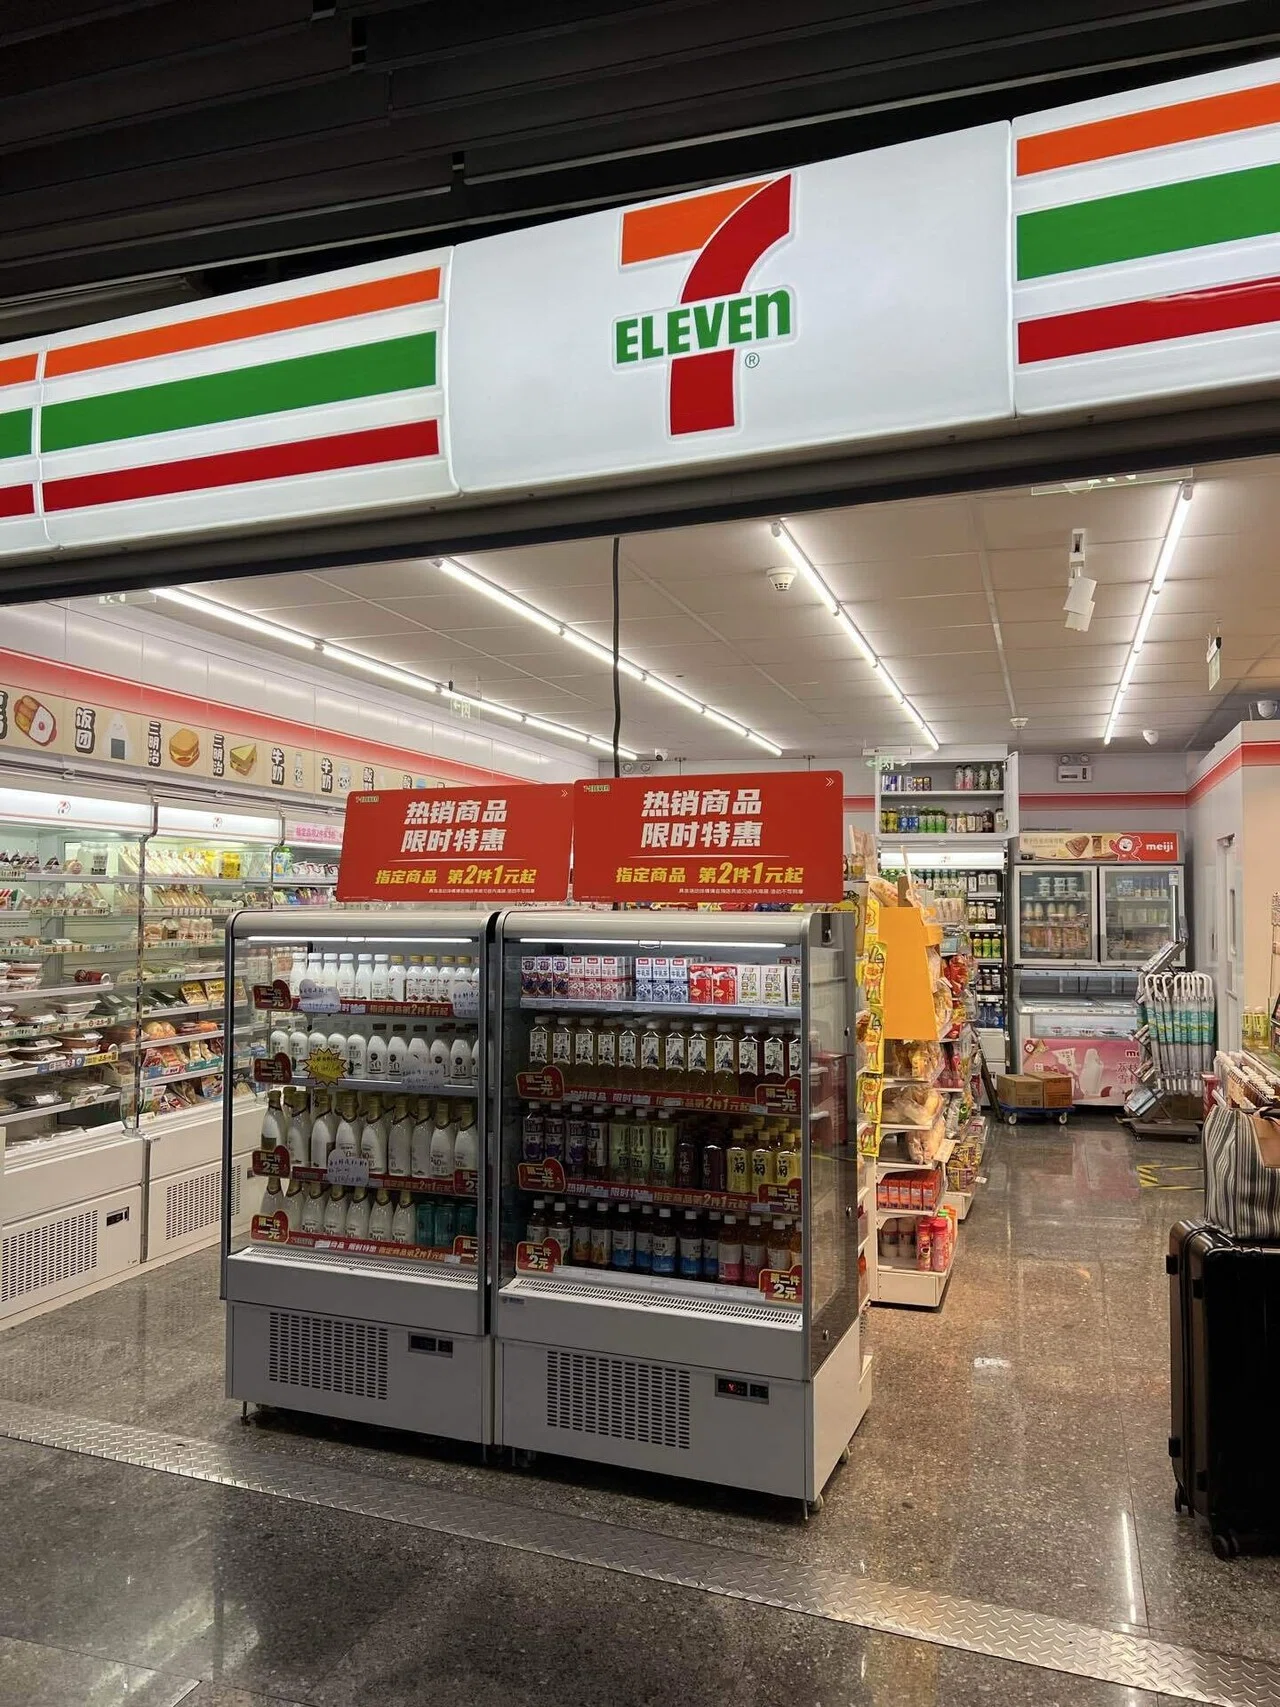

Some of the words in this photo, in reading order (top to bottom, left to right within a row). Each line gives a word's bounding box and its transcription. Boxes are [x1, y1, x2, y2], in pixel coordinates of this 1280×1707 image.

[621, 173, 791, 436] 7
[74, 707, 96, 754] 饭团
[271, 748, 285, 786] 牛奶
[320, 757, 333, 793] 牛奶
[403, 799, 508, 825] 热销商品
[641, 788, 763, 817] 热销商品
[400, 828, 507, 853] 限时特惠
[640, 820, 763, 848] 限时特惠
[1146, 841, 1174, 852] meiji
[375, 869, 437, 885] 指定商品
[448, 864, 537, 885] 第2件1元起
[615, 867, 686, 884] 指定商品
[698, 862, 805, 885] 第2件1元起
[262, 1161, 280, 1175] 2元
[529, 1255, 549, 1269] 2元
[770, 1272, 800, 1285] 第二件
[773, 1283, 797, 1299] 2元
